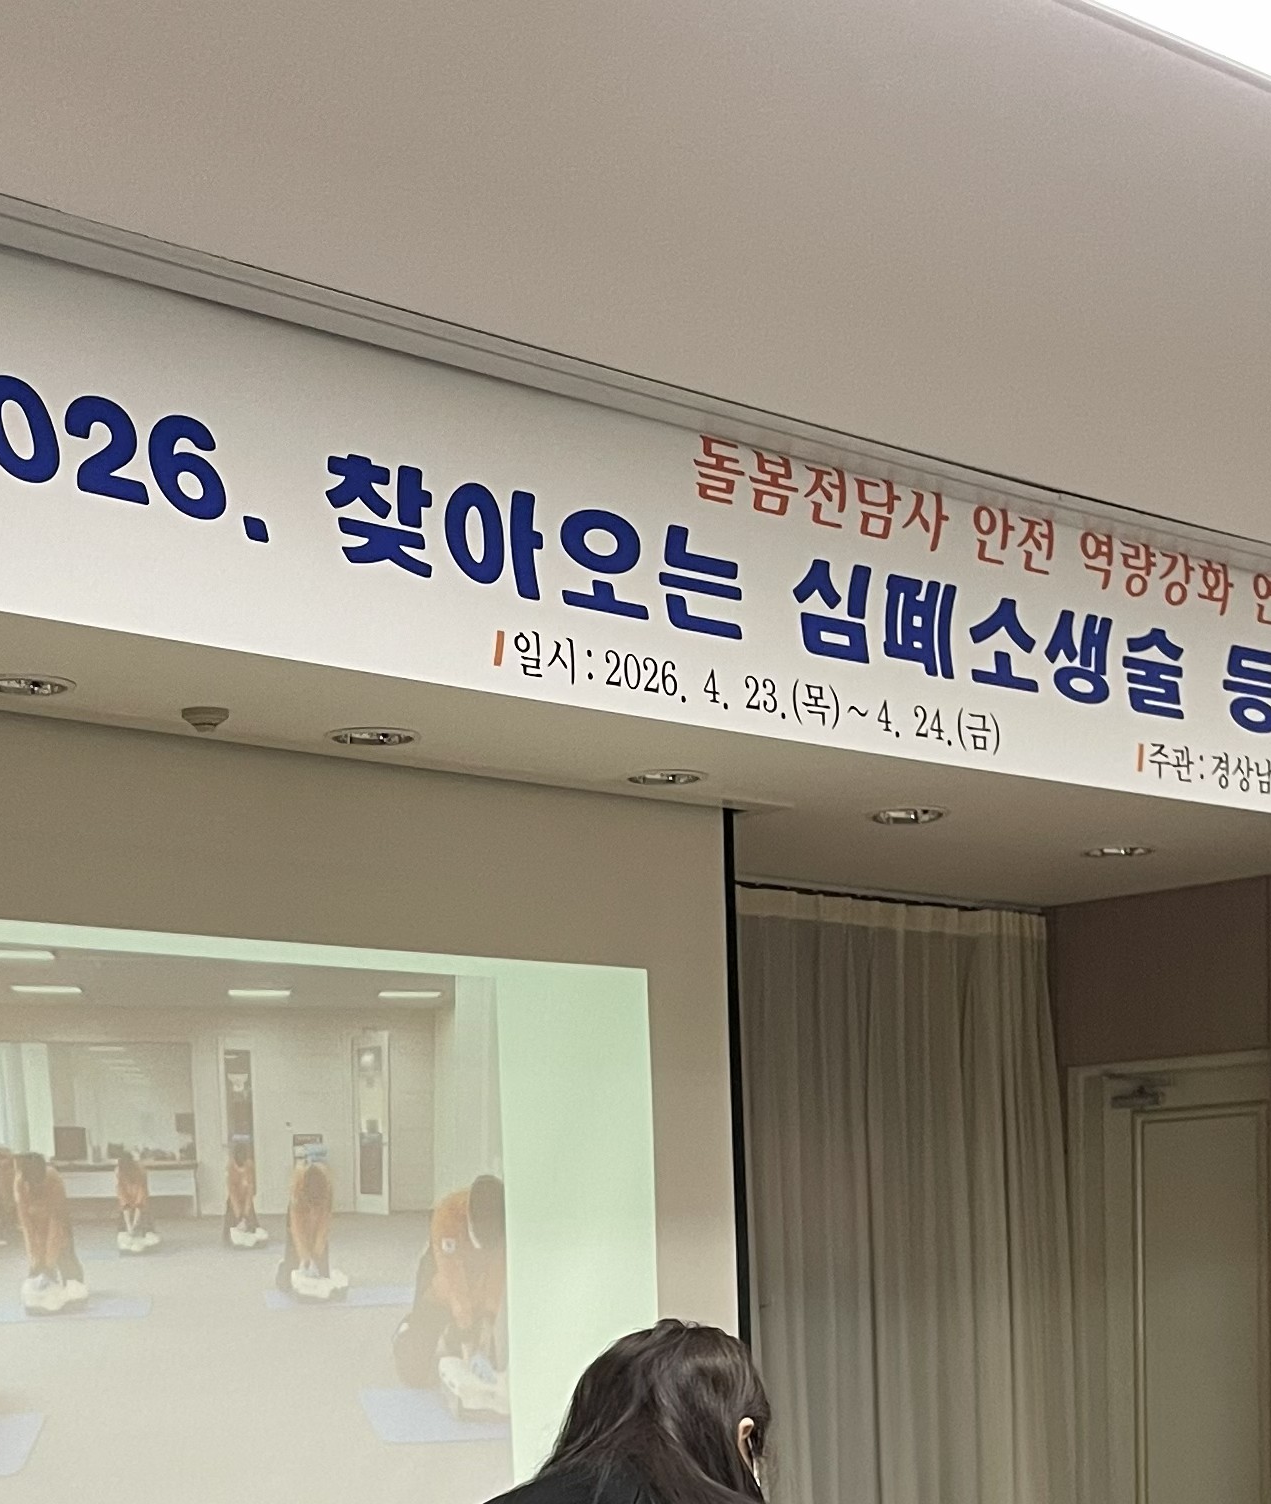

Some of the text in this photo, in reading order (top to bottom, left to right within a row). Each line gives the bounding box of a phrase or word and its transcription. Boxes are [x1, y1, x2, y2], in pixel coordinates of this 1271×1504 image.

[325, 453, 744, 640] 찾아오는
[792, 558, 1185, 721] 심폐소생술
[693, 432, 950, 553] 돌봄전담사
[971, 502, 1056, 576] 안전
[1078, 527, 1234, 616] 역량강화
